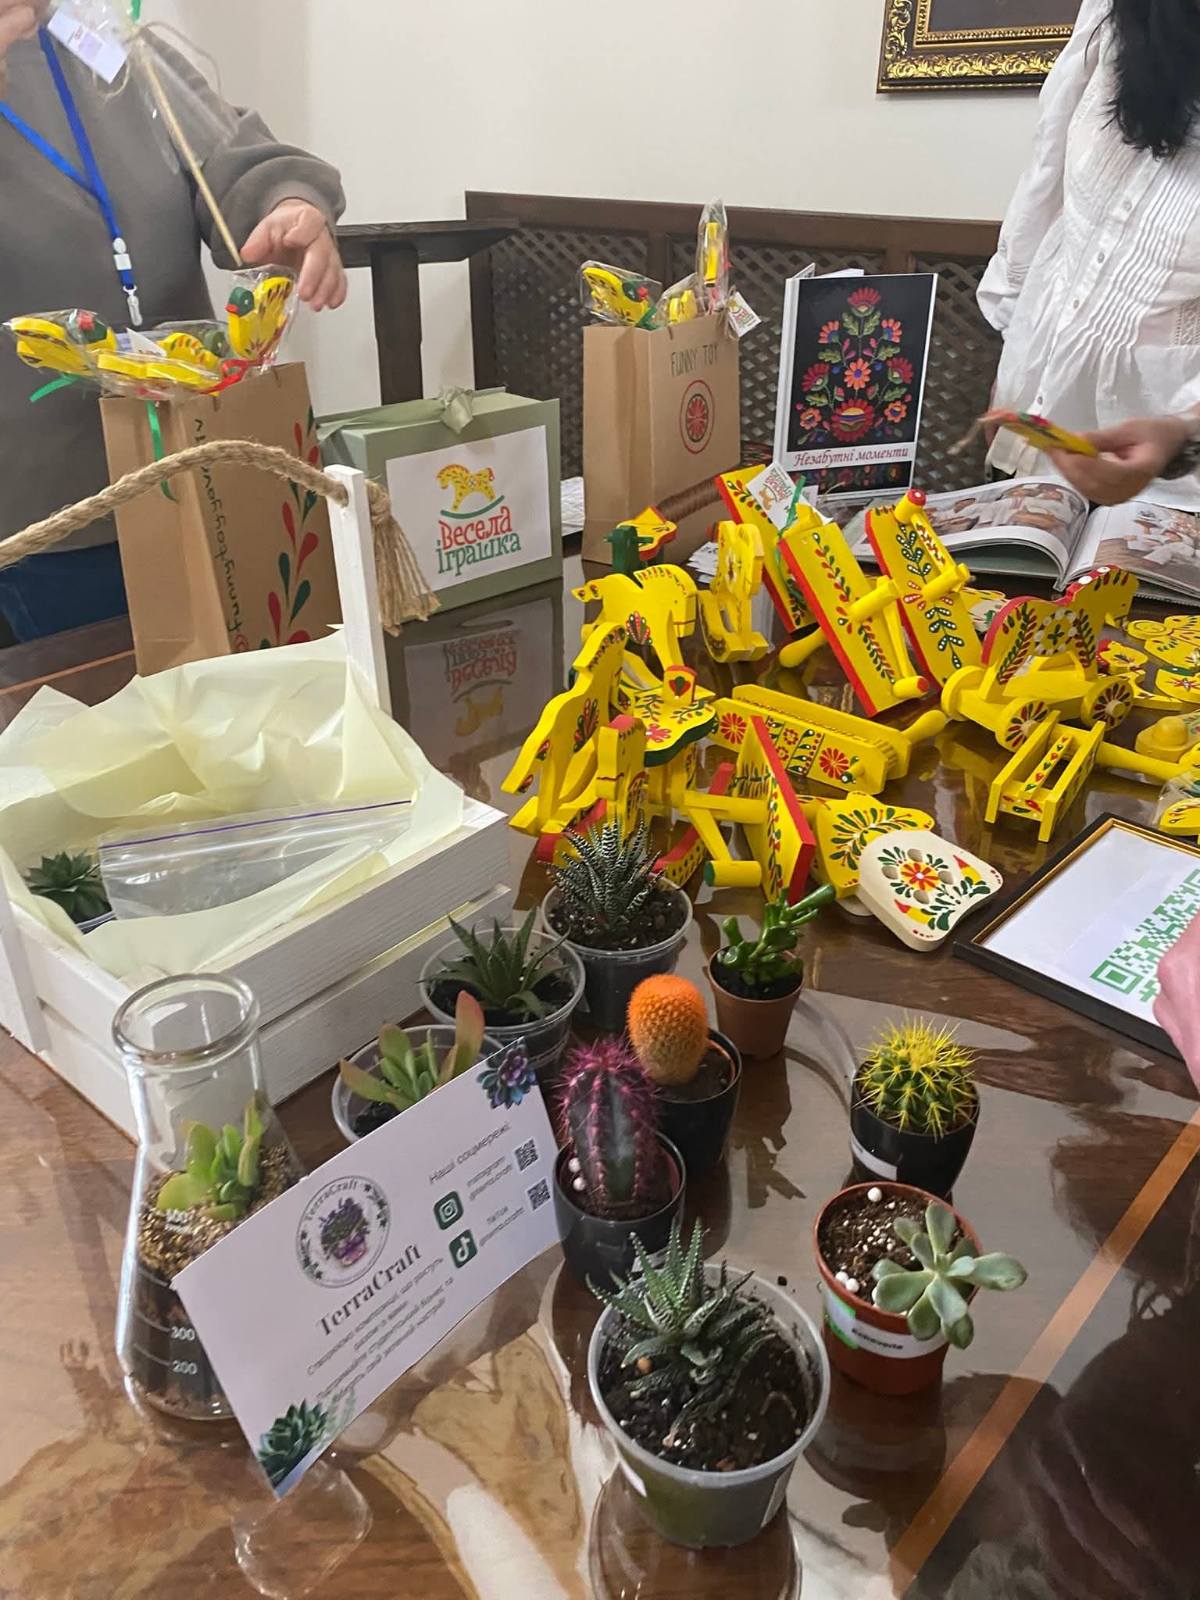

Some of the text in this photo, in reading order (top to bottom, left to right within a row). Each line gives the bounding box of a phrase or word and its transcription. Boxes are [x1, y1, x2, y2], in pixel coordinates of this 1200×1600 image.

[671, 343, 719, 377] FUNNY TOY
[794, 447, 909, 467] Незабутні моменти
[438, 505, 513, 550] Весела
[436, 532, 522, 576] іграшка
[316, 1244, 422, 1336] TerraCraft
[171, 1326, 196, 1342] 300
[172, 1360, 198, 1375] 200
